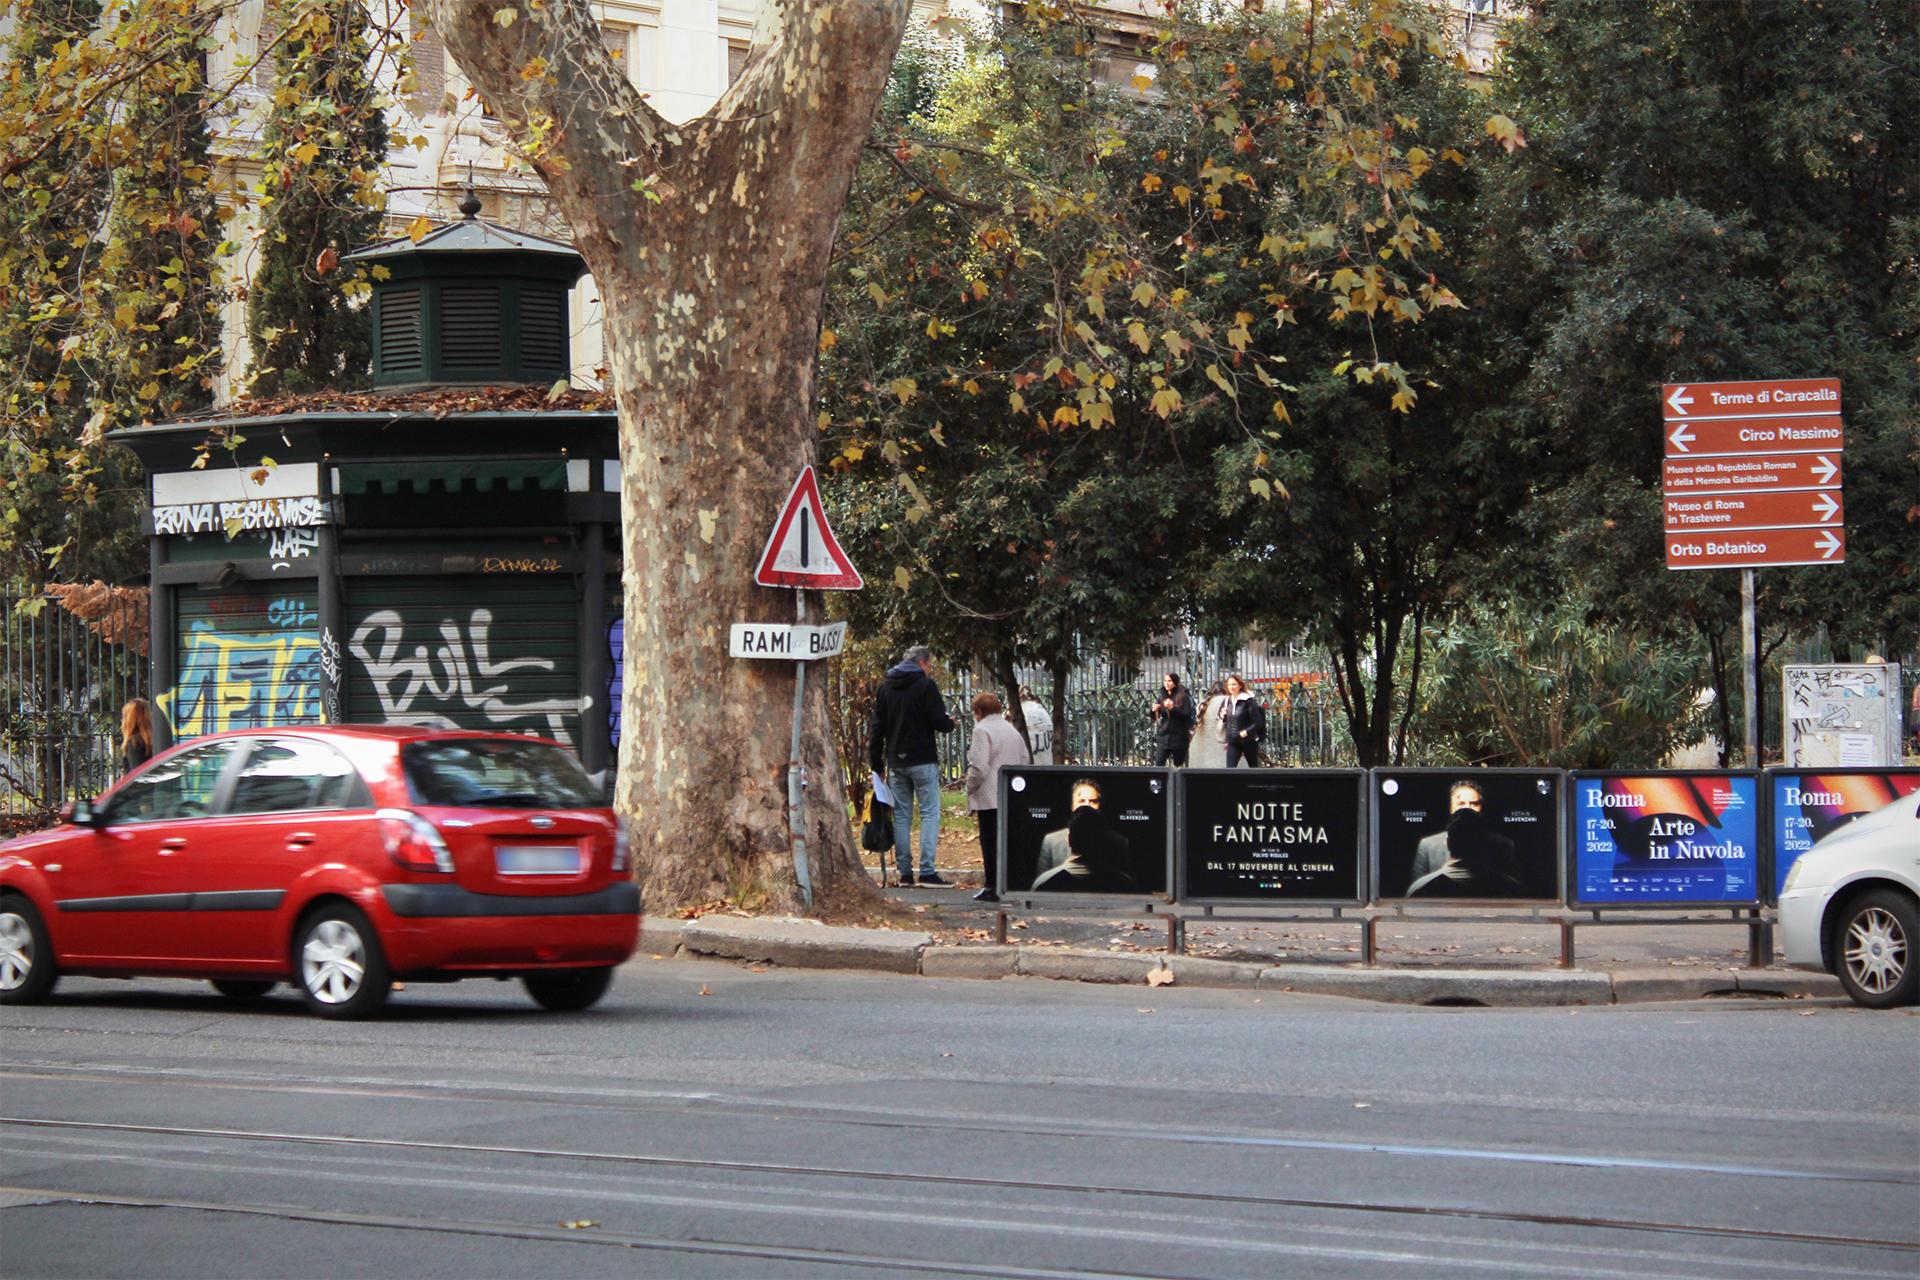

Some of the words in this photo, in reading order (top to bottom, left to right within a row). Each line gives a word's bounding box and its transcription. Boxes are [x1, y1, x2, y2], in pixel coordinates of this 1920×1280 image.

[1711, 391, 1754, 405] Terme
[1757, 390, 1770, 403] di
[1773, 388, 1837, 402] Caracalla
[1739, 429, 1775, 442] Circo
[1779, 427, 1840, 440] Massimo
[1667, 465, 1694, 474] Museo
[1696, 464, 1716, 473] della
[1717, 462, 1761, 473] Repubblica
[1763, 462, 1797, 470] Romana
[1674, 478, 1694, 486] della
[1695, 476, 1731, 485] Memoria
[1732, 474, 1778, 483] Garibaldina
[1668, 501, 1701, 512] Museo
[1703, 500, 1713, 510] di
[1715, 499, 1745, 509] Roma
[1667, 514, 1678, 524] in
[1679, 512, 1732, 523] Trastevere
[1670, 543, 1702, 556] Orto
[1706, 541, 1767, 555] Botanico
[742, 630, 792, 653] RAMI
[809, 629, 842, 654] BASSI
[1586, 789, 1646, 808] Roma
[1784, 787, 1844, 806] Roma
[1237, 803, 1303, 821] NOTTE
[1586, 819, 1617, 829] 17-20.
[1649, 817, 1695, 836] Arte
[1784, 817, 1814, 828] 17-20.
[1213, 825, 1329, 844] FANTASMA
[1586, 831, 1599, 841] 11.
[1784, 829, 1797, 839] 11.
[1586, 842, 1613, 852] 2022
[1649, 840, 1670, 860] in
[1675, 840, 1745, 859] Nuvola
[1784, 839, 1811, 850] 2022
[1207, 862, 1224, 870] DAL
[1227, 862, 1236, 870] 17
[1239, 863, 1284, 871] NOVEMBRE
[1288, 864, 1298, 872] AL
[1302, 864, 1335, 872] CINEMA
